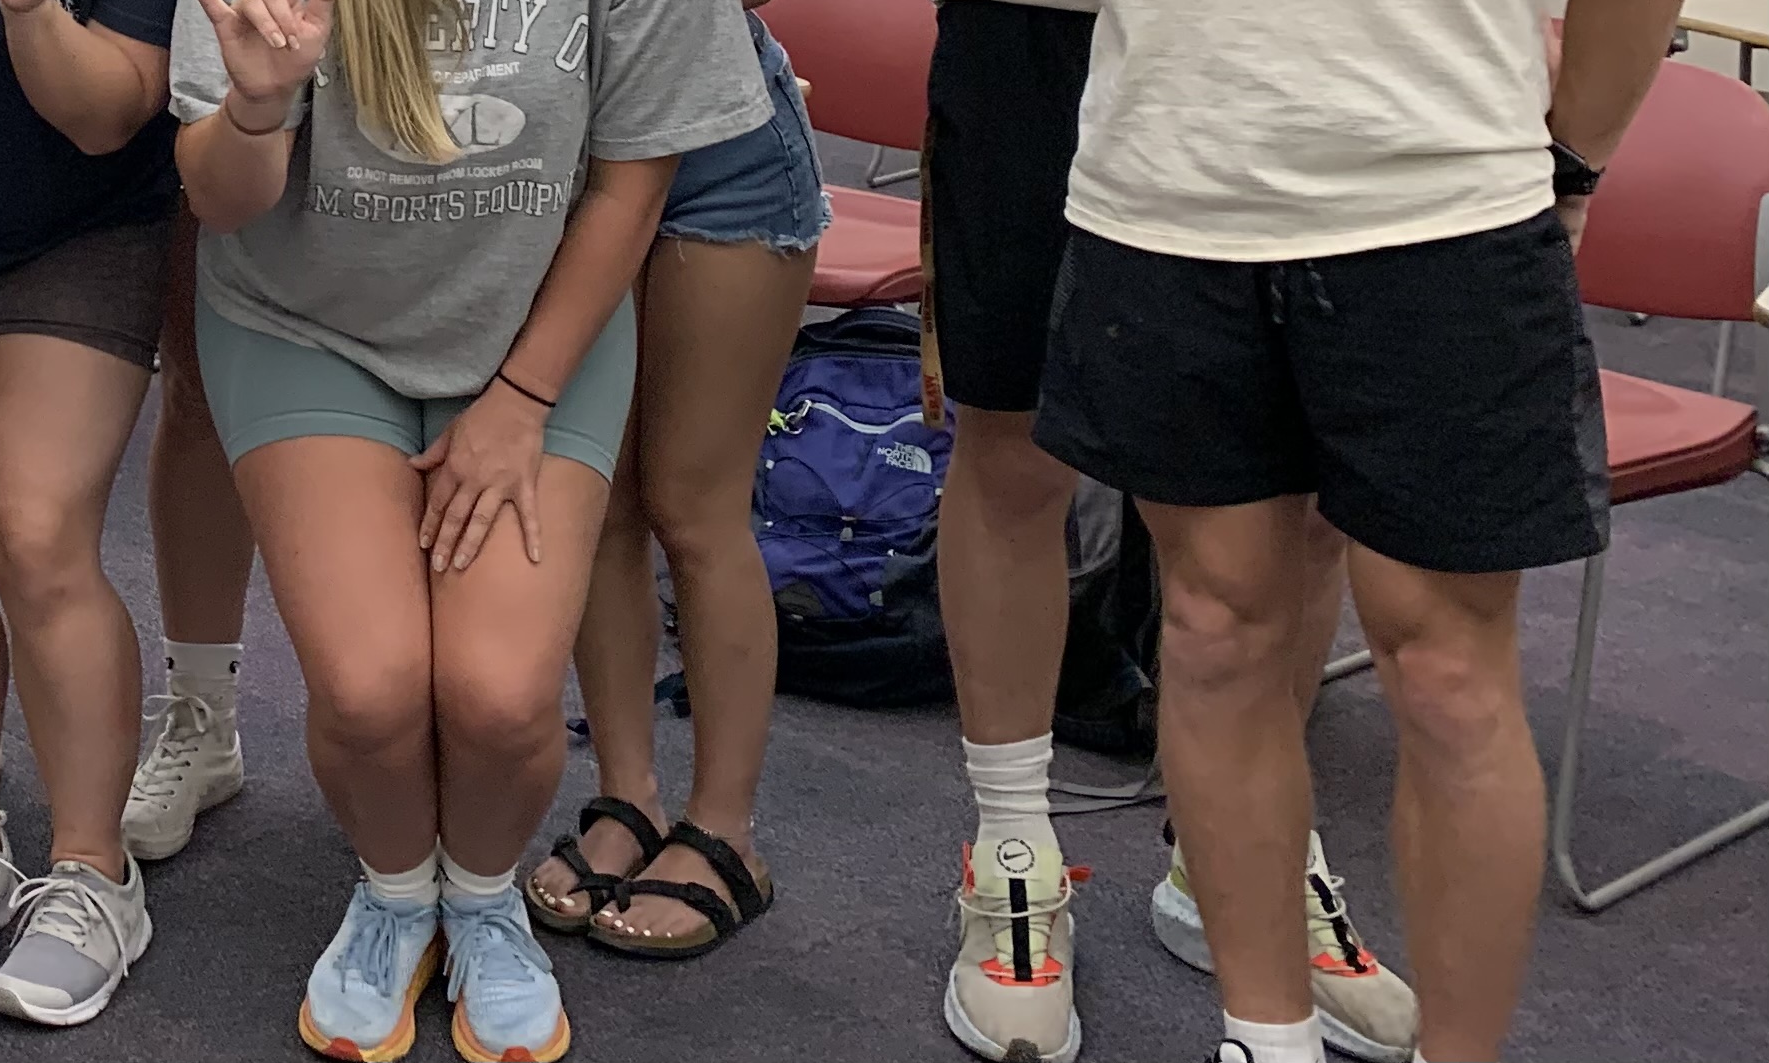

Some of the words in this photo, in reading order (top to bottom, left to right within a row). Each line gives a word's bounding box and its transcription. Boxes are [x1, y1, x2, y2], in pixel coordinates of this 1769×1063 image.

[554, 12, 590, 82] O
[346, 166, 363, 180] DO
[365, 168, 386, 182] NOT
[388, 173, 435, 185] REMOVE
[436, 167, 466, 182] FROM
[467, 164, 510, 178] LOCKER
[511, 158, 543, 172] ROOM
[352, 189, 466, 224] SPORTS
[876, 447, 912, 462] NORTH
[885, 457, 916, 471] FACE
